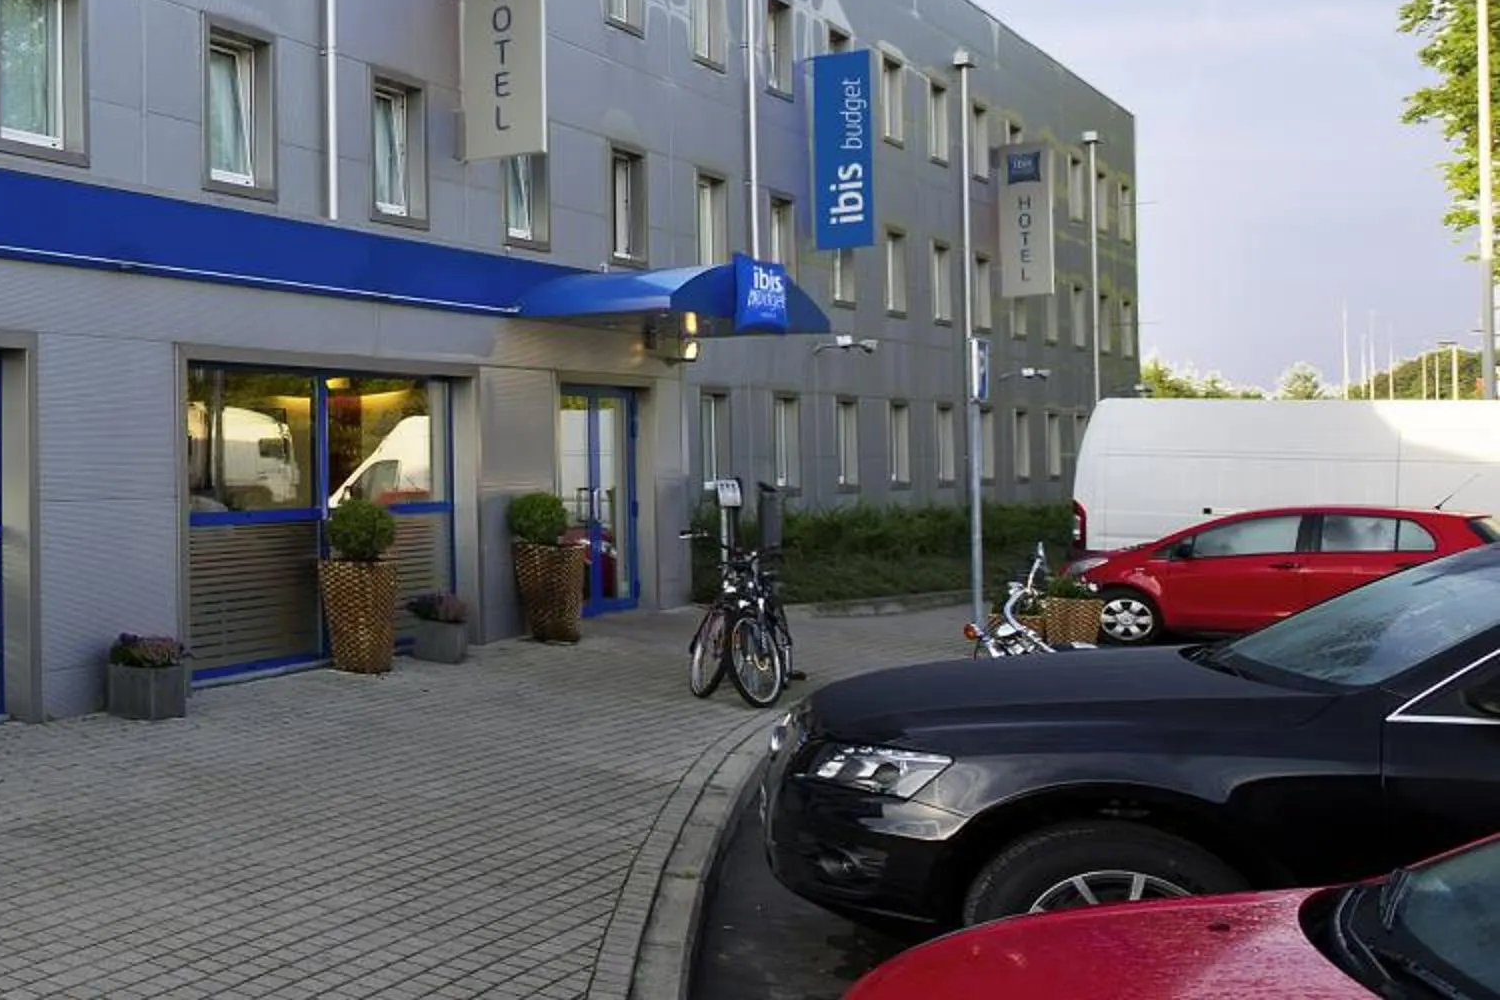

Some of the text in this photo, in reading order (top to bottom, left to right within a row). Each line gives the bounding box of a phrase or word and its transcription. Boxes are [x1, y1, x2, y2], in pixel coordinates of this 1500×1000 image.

[829, 76, 868, 225] ibis budget
[753, 265, 785, 293] ibis
[1018, 194, 1032, 282] HOTEL
